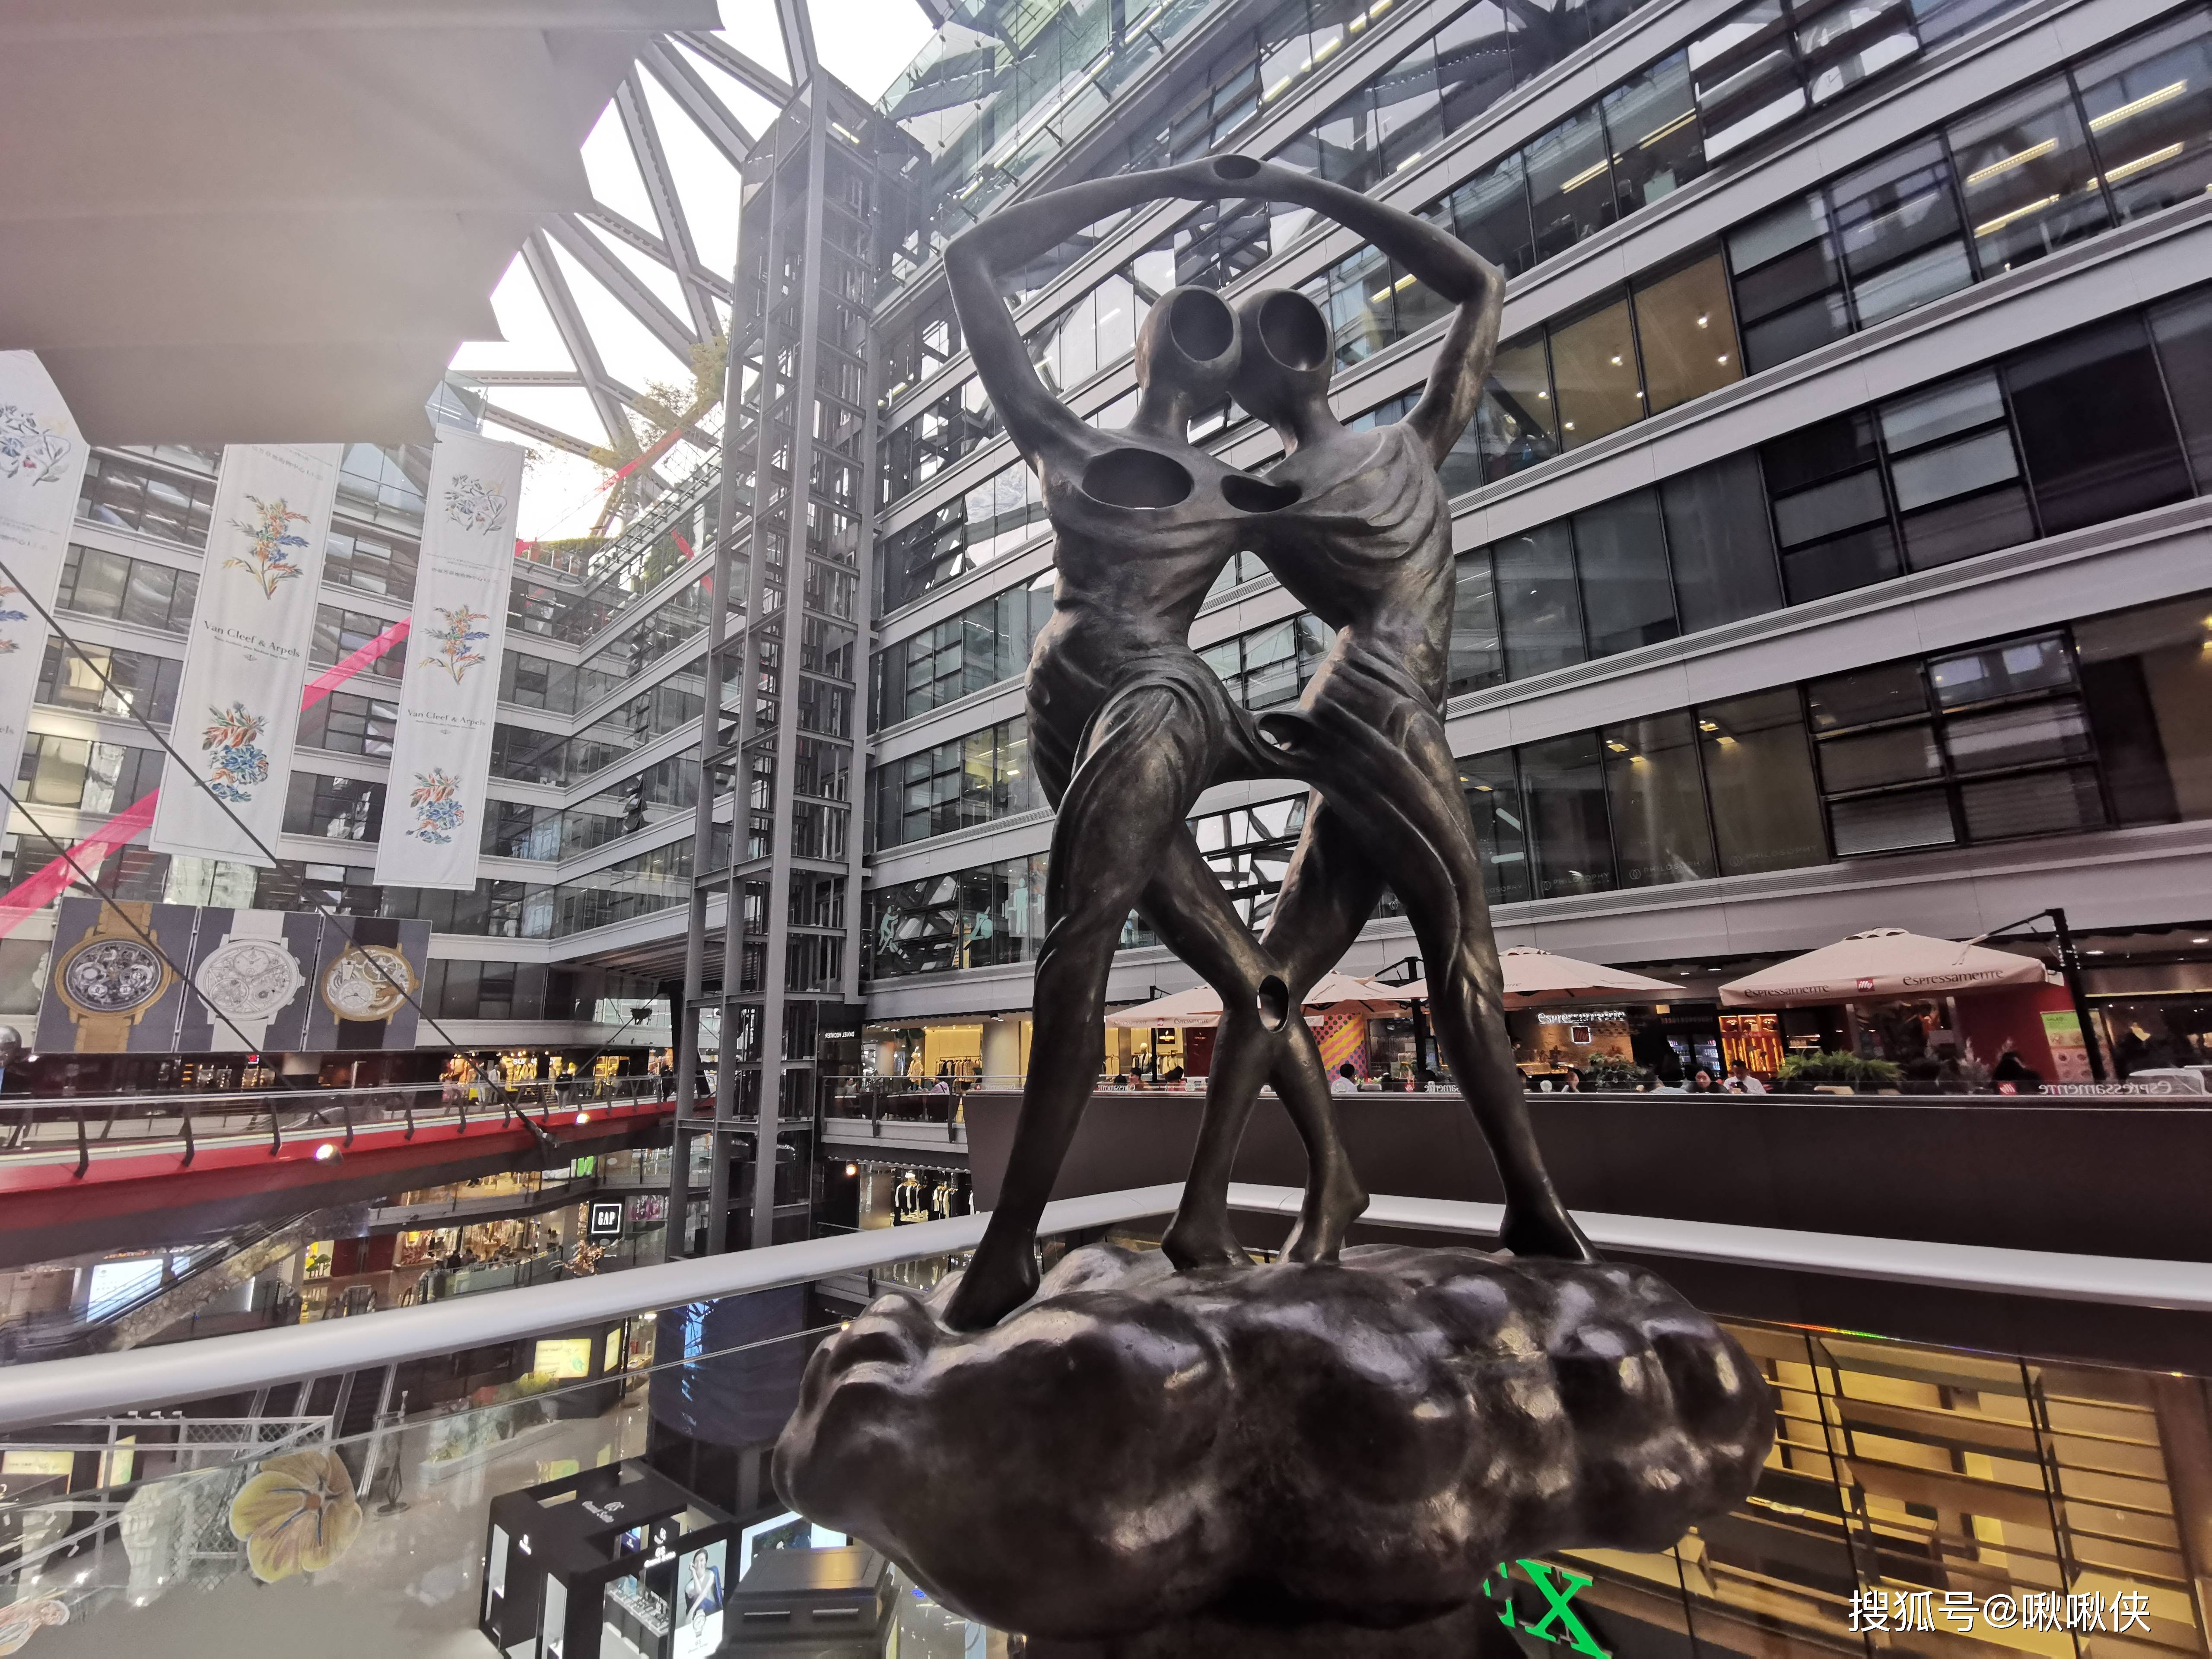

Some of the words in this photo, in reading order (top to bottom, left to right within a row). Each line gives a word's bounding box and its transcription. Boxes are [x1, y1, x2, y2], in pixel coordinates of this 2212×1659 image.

[204, 620, 223, 634] Van
[227, 629, 257, 643] Cleef
[269, 642, 300, 657] Arpels
[408, 709, 423, 717] Van
[426, 712, 448, 721] Cleef
[460, 717, 485, 726] Arpels
[0, 725, 14, 734] els
[1485, 884, 1522, 894] LOSOPHY
[1744, 985, 1830, 998] espressamente
[1858, 980, 1873, 990] illy
[1903, 970, 2003, 986] espressamente
[598, 1211, 616, 1225] GAP
